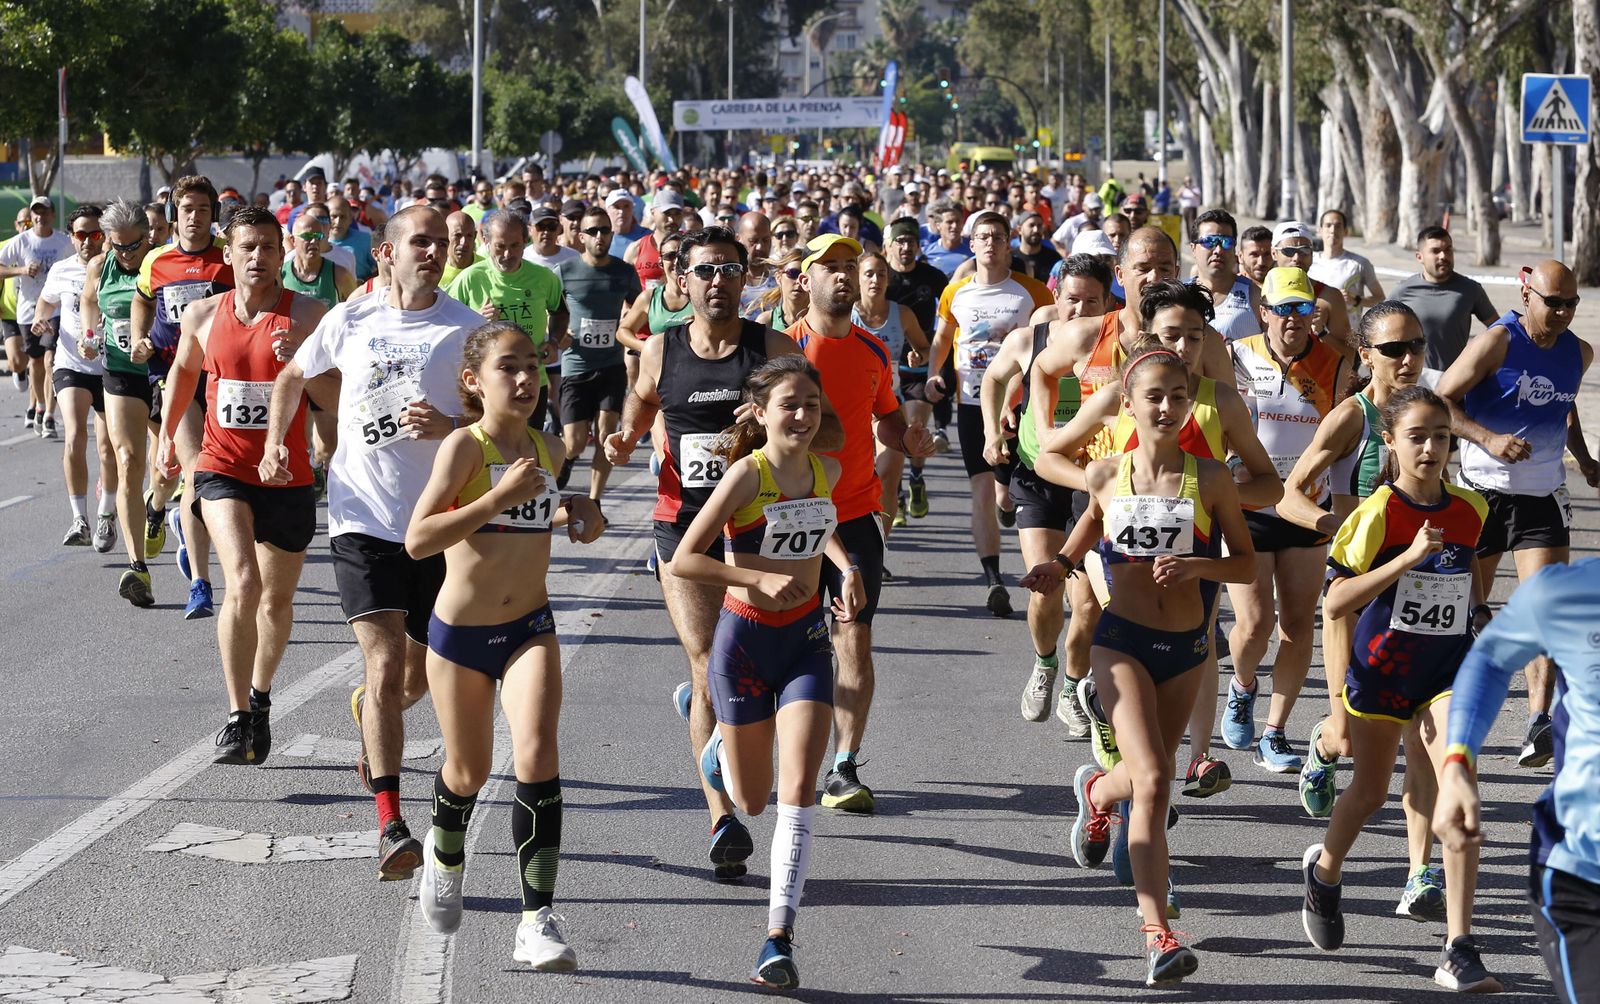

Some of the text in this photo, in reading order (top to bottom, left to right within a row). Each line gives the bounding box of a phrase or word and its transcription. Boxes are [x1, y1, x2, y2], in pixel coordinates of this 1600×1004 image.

[711, 103, 762, 115] CARRERA
[765, 103, 779, 113] DE
[782, 103, 796, 112] LA
[800, 101, 842, 112] PRENSA
[118, 335, 132, 349] 5
[583, 332, 610, 345] 613
[222, 404, 268, 425] 132
[501, 498, 551, 522] 481
[773, 503, 798, 512] CARRERA
[771, 528, 827, 554] 707
[1116, 525, 1182, 550] 437
[1410, 573, 1438, 582] CARRERA
[1399, 600, 1456, 629] 549
